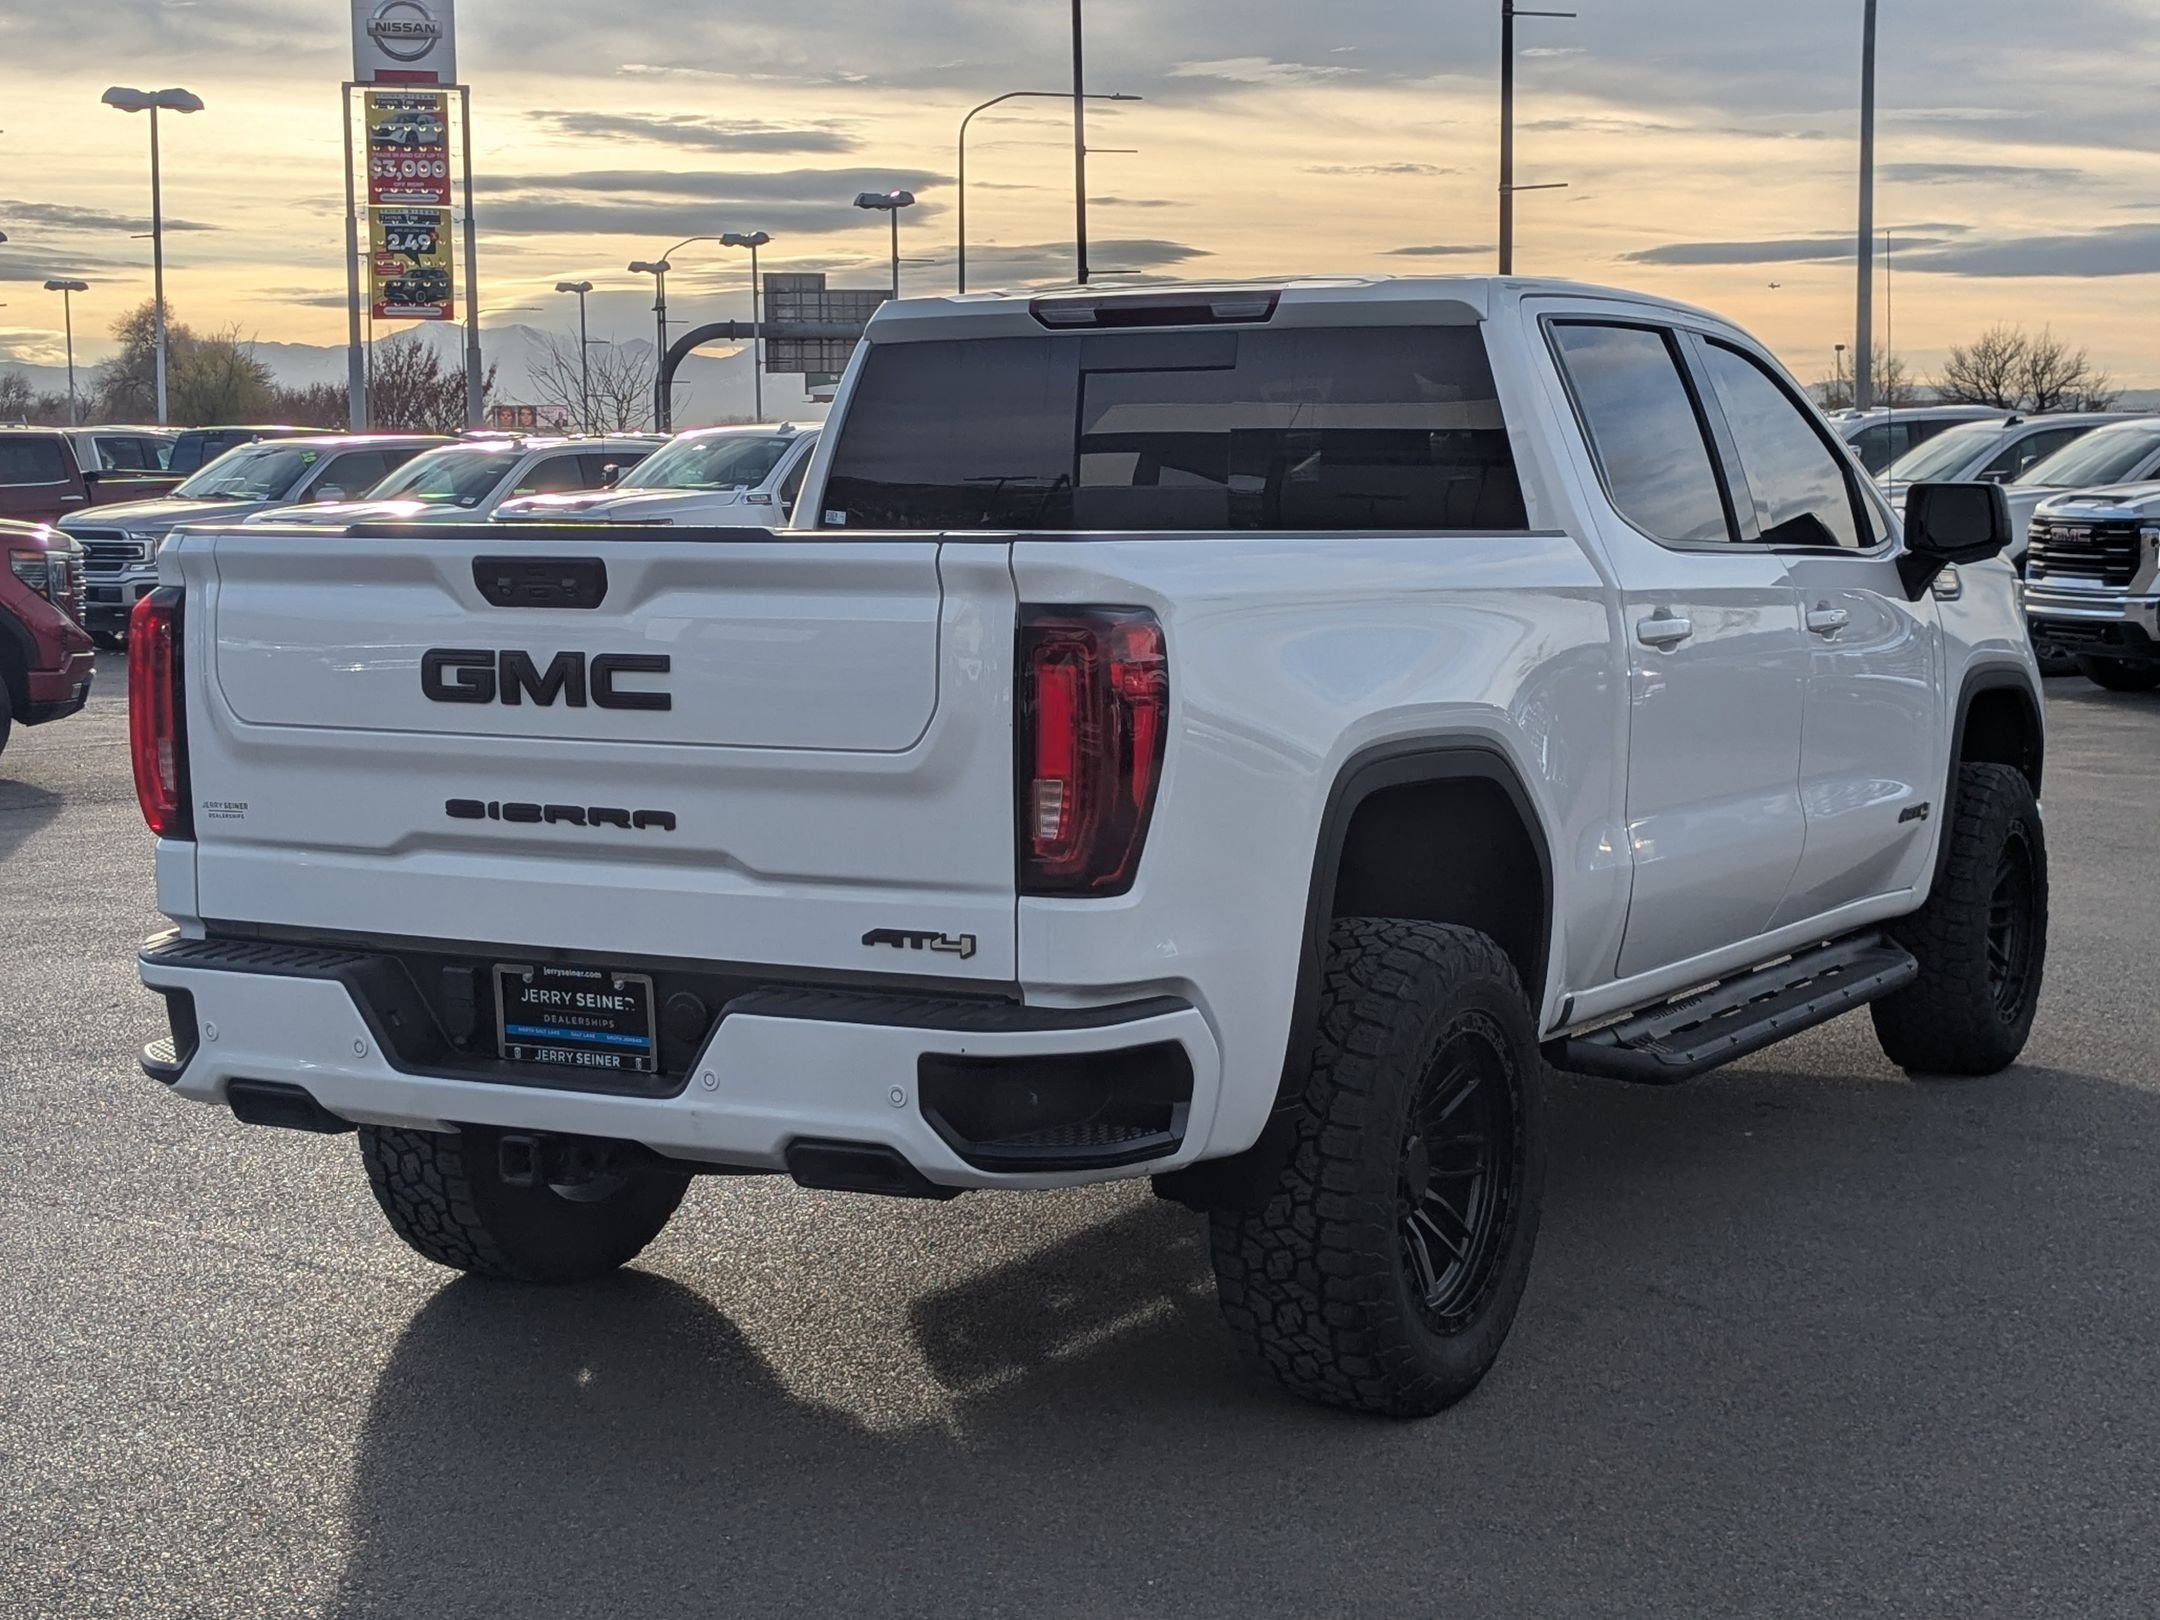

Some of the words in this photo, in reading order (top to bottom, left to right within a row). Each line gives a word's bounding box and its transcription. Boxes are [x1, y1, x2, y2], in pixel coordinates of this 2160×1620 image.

[375, 22, 436, 34] NISSAN
[370, 157, 447, 181] $3,000
[2050, 527, 2092, 542] GMC
[421, 648, 672, 711] GMC
[202, 801, 223, 809] JERRY
[224, 802, 249, 810] SEINER
[445, 798, 676, 832] SIERRA
[862, 928, 976, 960] AT4
[543, 966, 602, 979] jerryseiner.com
[521, 988, 572, 1005] JERRY
[543, 1014, 615, 1029] DEALERSHIPS
[535, 1049, 573, 1063] JERRY
[576, 1053, 621, 1068] SEINER
